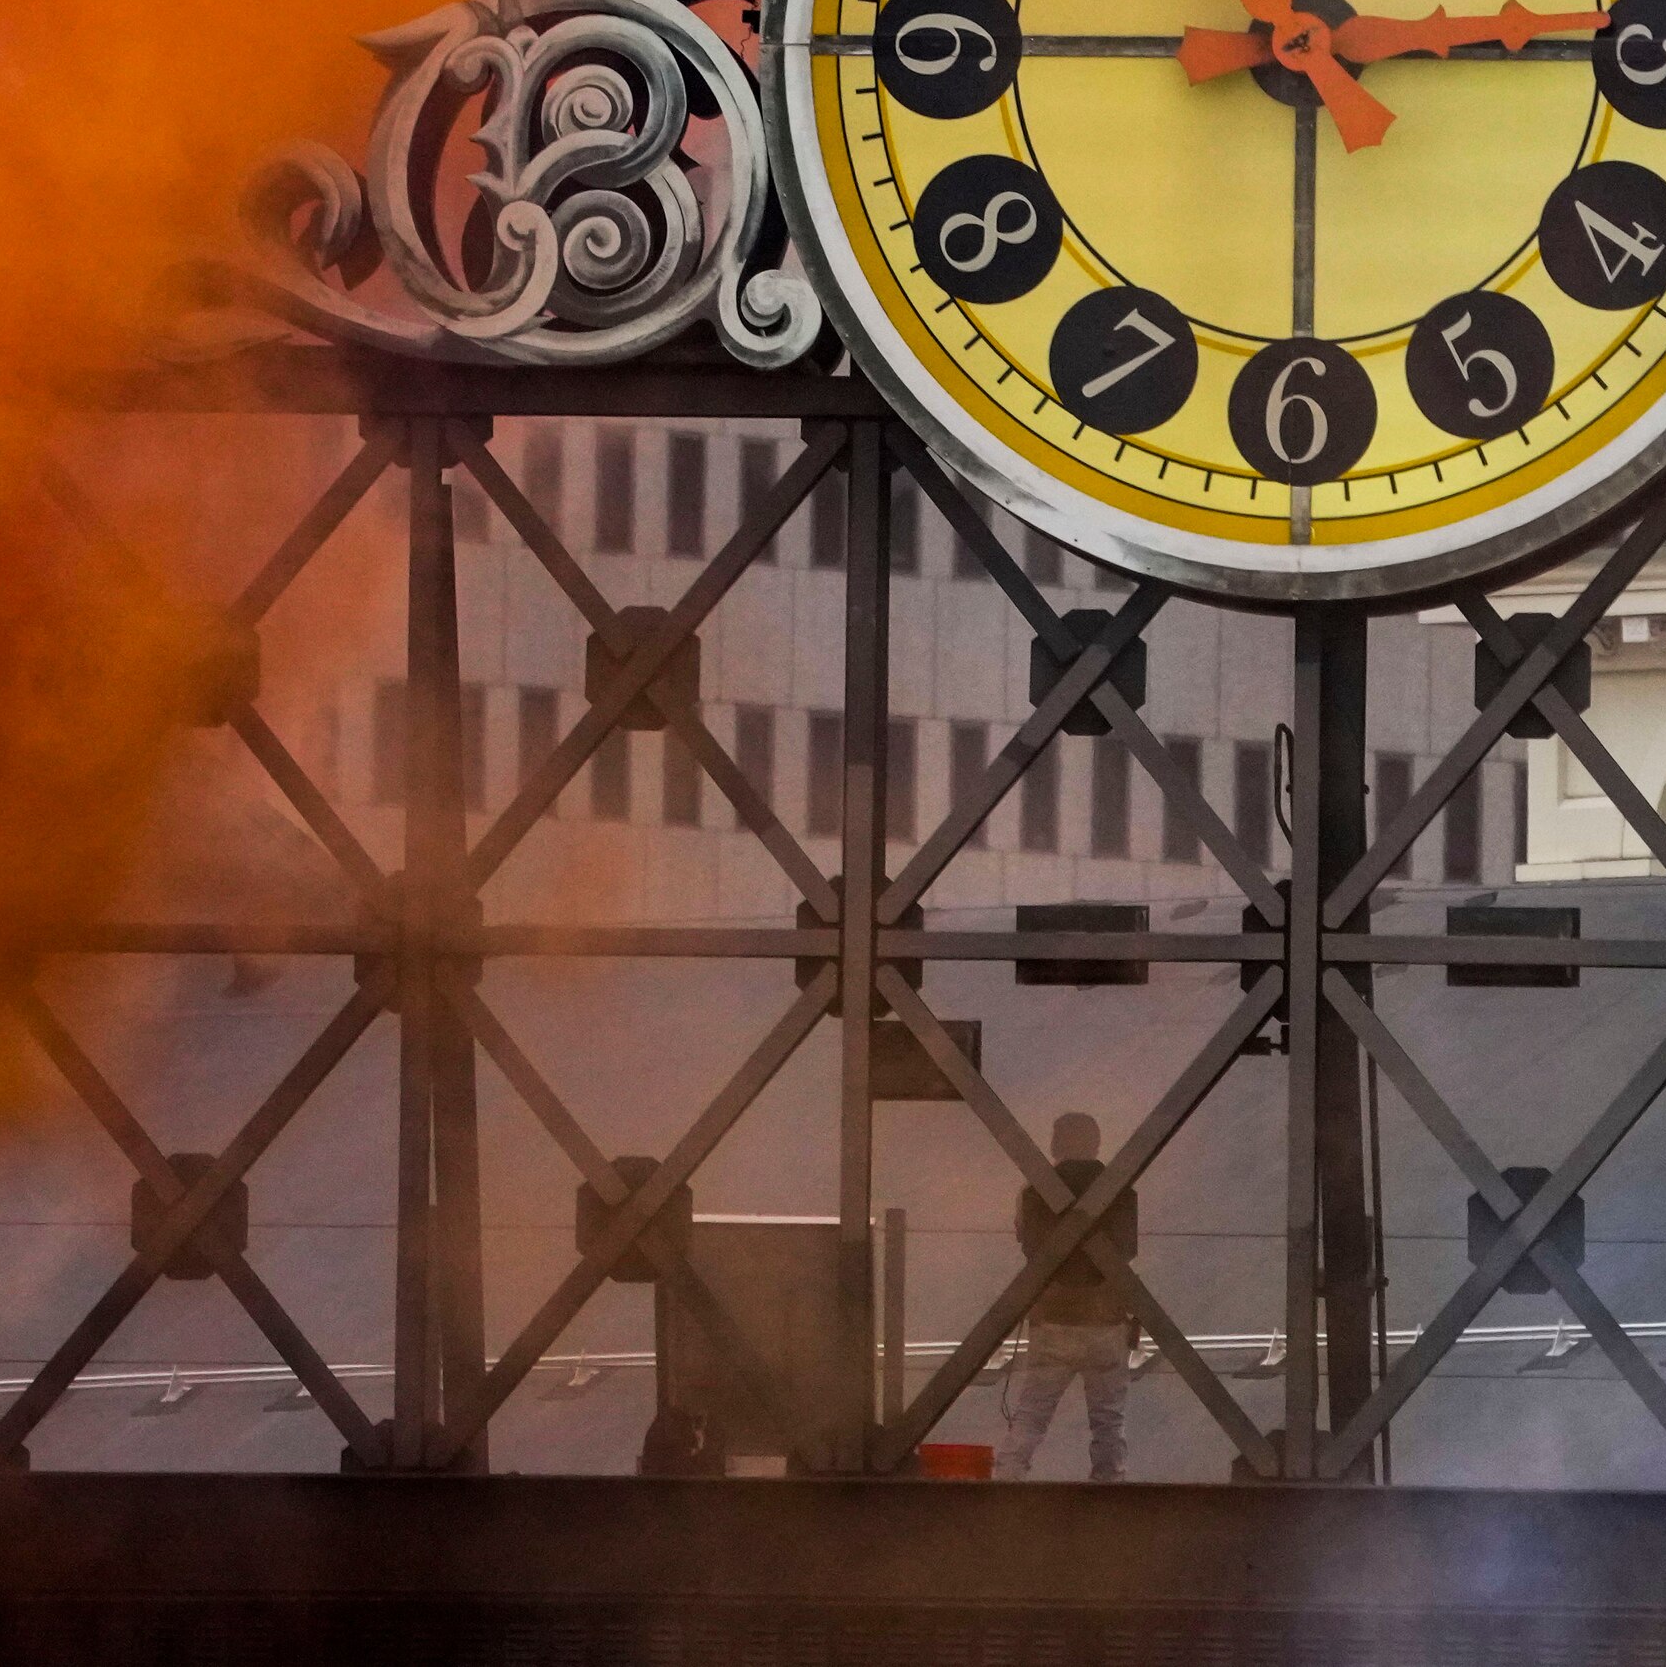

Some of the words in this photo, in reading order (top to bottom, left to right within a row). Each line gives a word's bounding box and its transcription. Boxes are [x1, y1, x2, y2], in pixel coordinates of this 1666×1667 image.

[895, 14, 996, 75] 9
[940, 192, 1038, 272] 8
[1575, 201, 1666, 284] 4
[1082, 309, 1176, 398] 7
[1441, 312, 1518, 418] 5
[1265, 358, 1329, 463] 6
